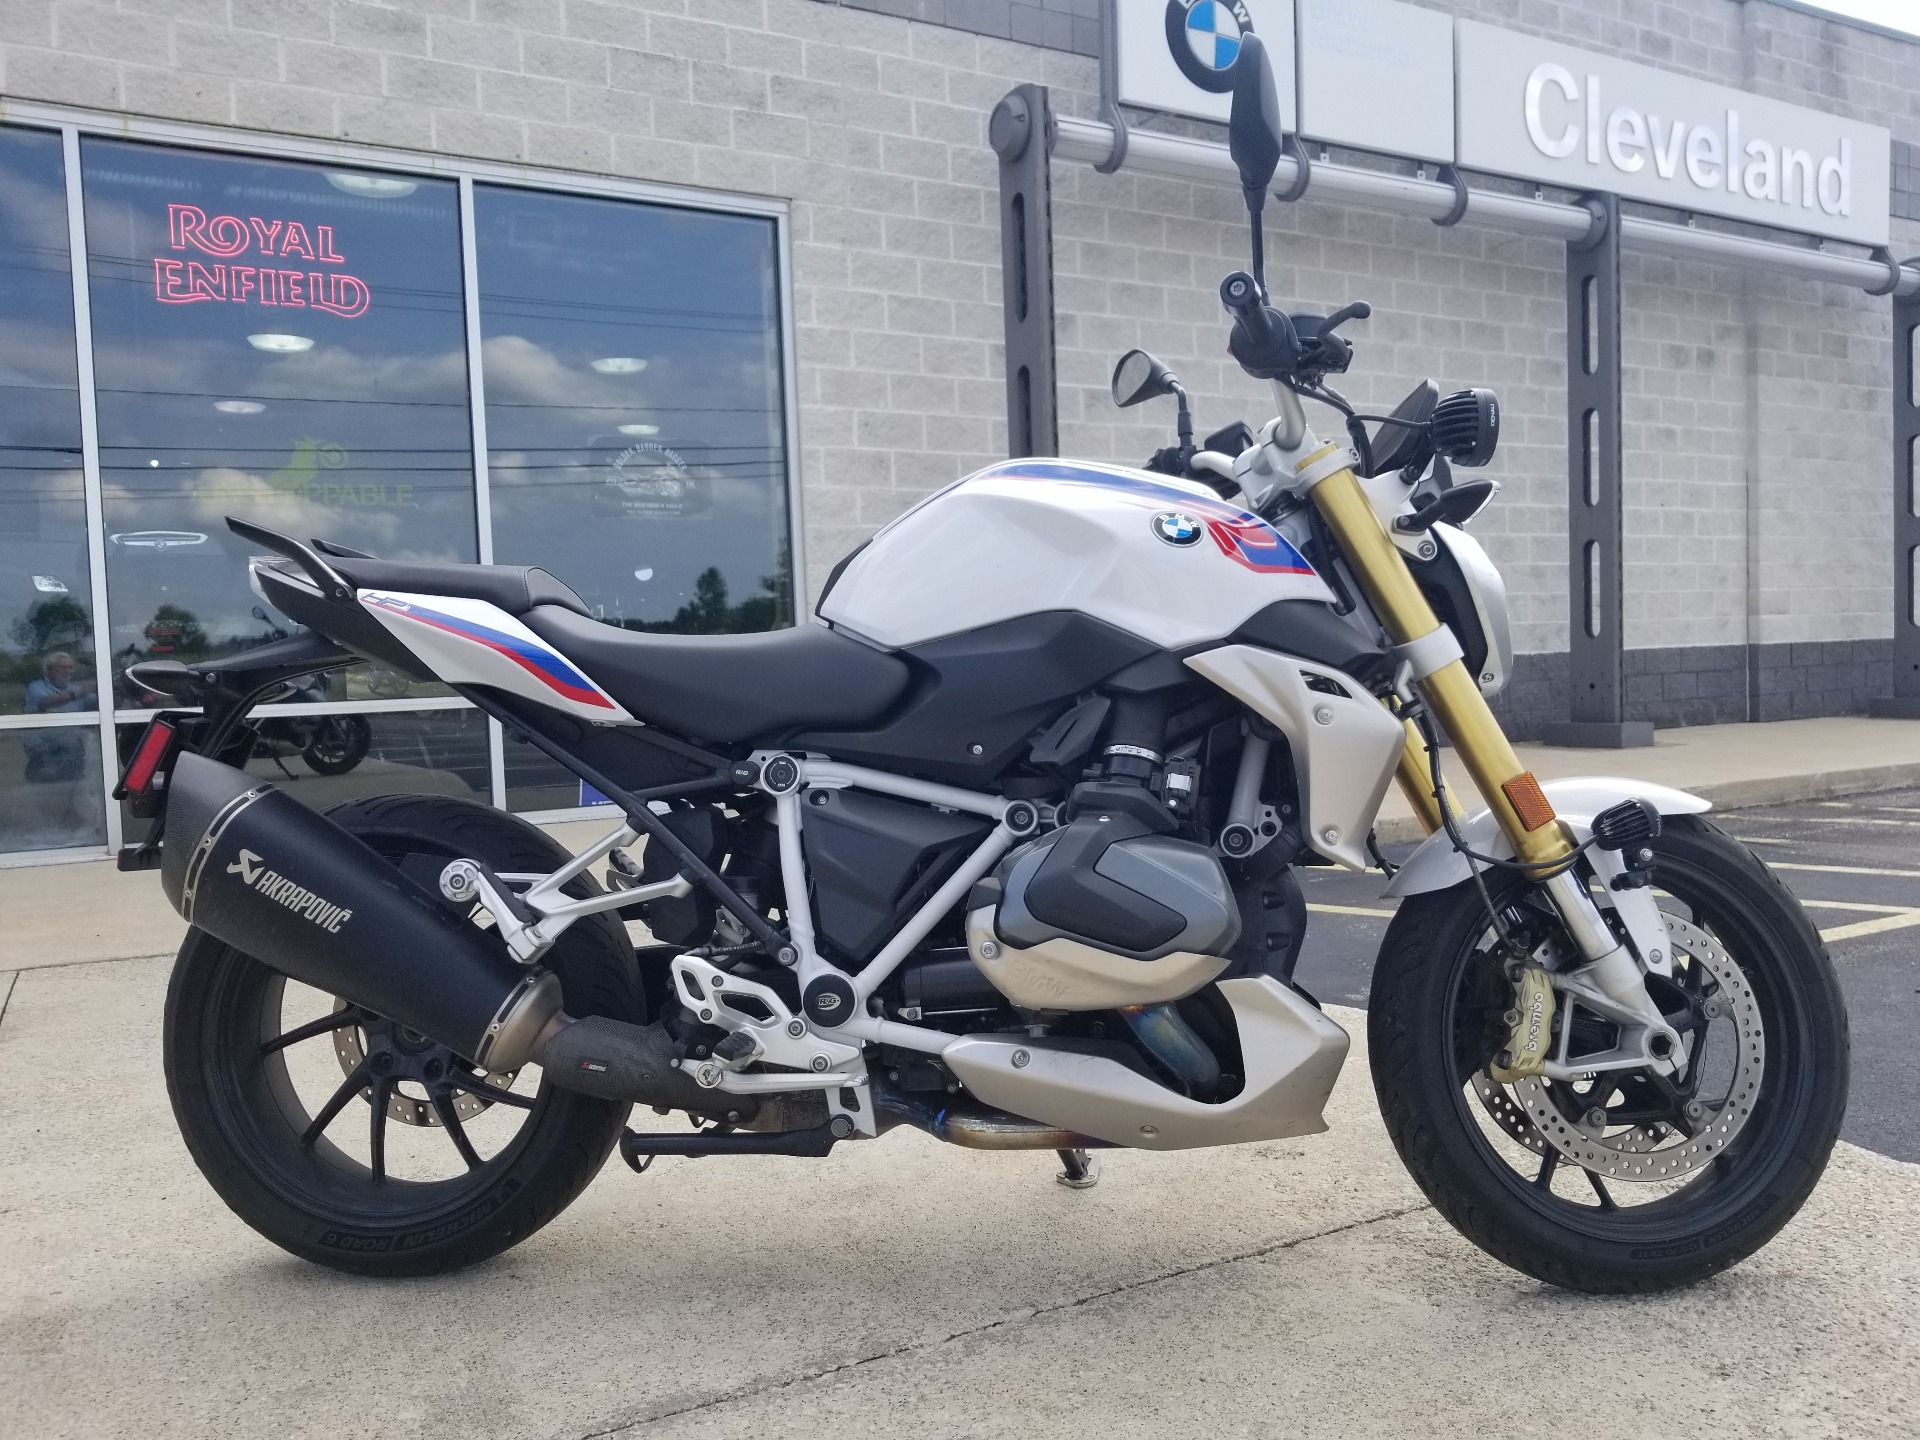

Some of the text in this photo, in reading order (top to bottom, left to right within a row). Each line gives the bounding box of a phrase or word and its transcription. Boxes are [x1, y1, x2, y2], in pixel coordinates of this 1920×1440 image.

[1524, 62, 1851, 217] Cleveland
[168, 203, 345, 264] ROYAL
[154, 258, 370, 318] ENFIELD
[1159, 513, 1200, 528] BMW
[1523, 991, 1544, 1052] brembo
[340, 1236, 388, 1250] ROAD
